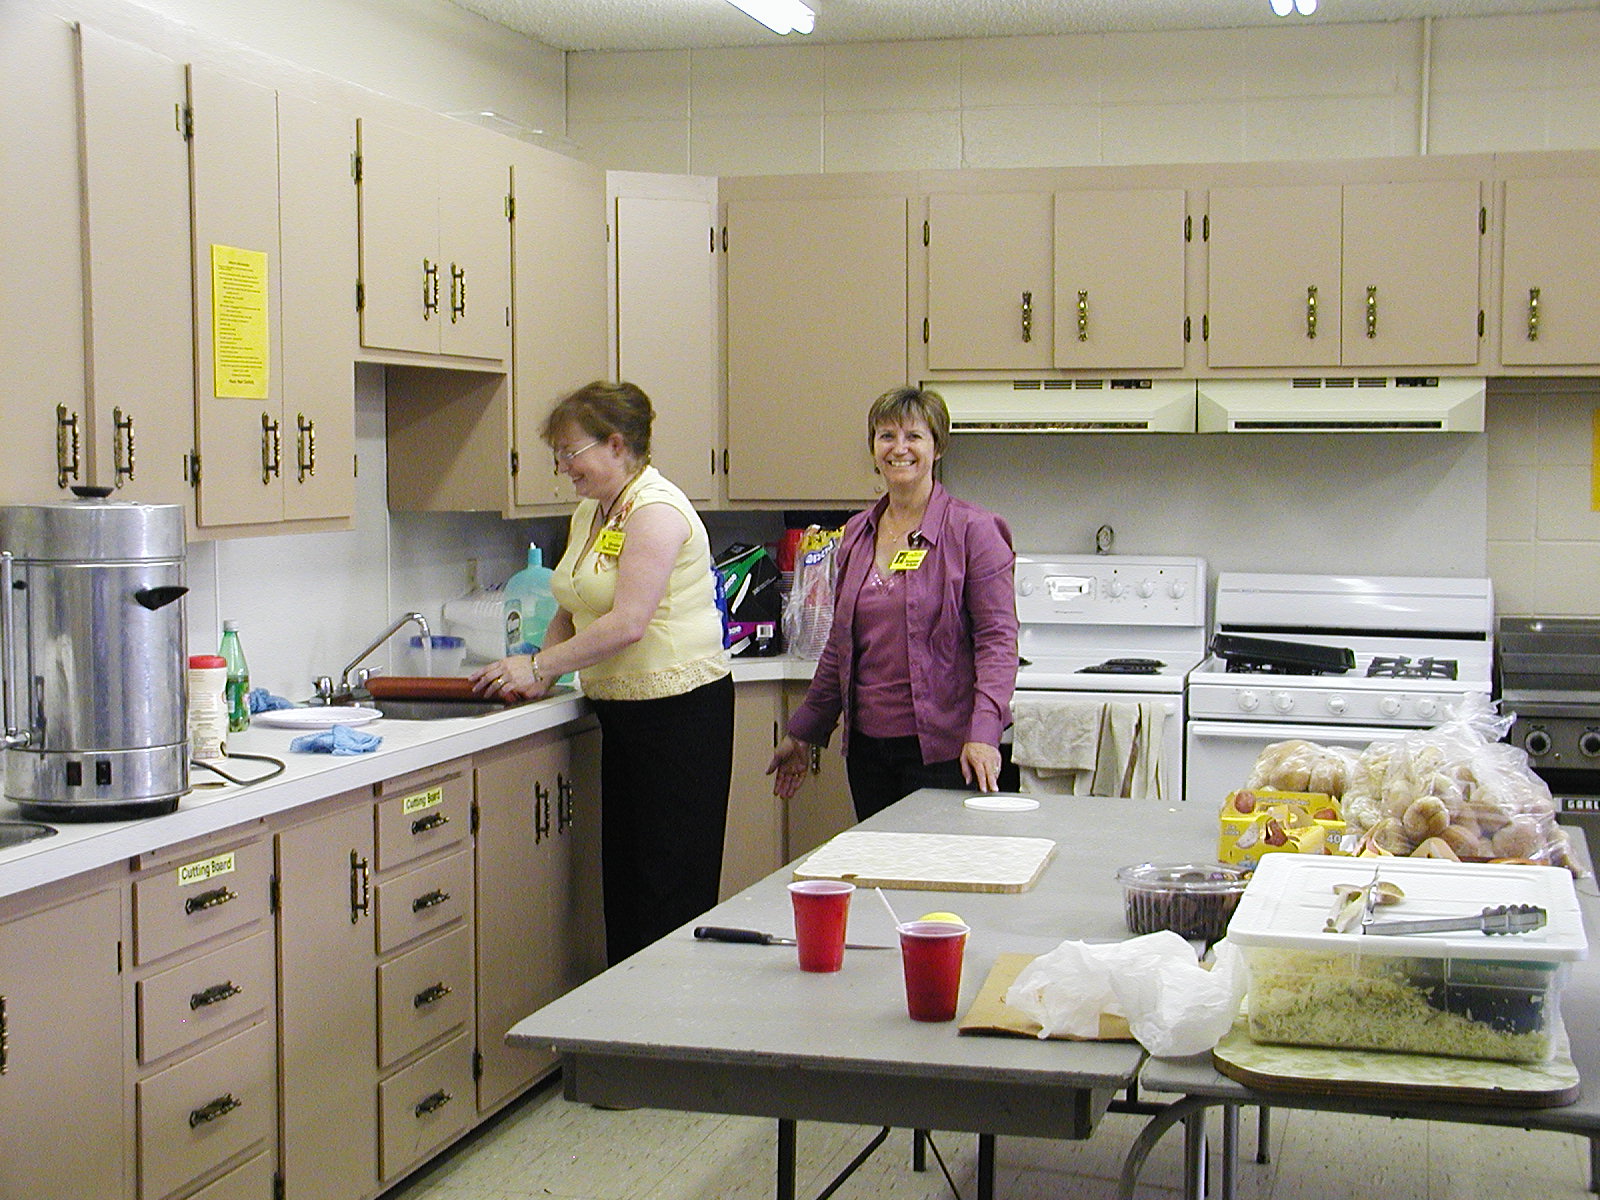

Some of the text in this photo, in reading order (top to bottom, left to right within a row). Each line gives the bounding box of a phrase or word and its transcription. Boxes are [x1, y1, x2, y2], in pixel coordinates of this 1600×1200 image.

[406, 789, 440, 809] Cutting Board
[182, 858, 232, 880] Cutting Board
